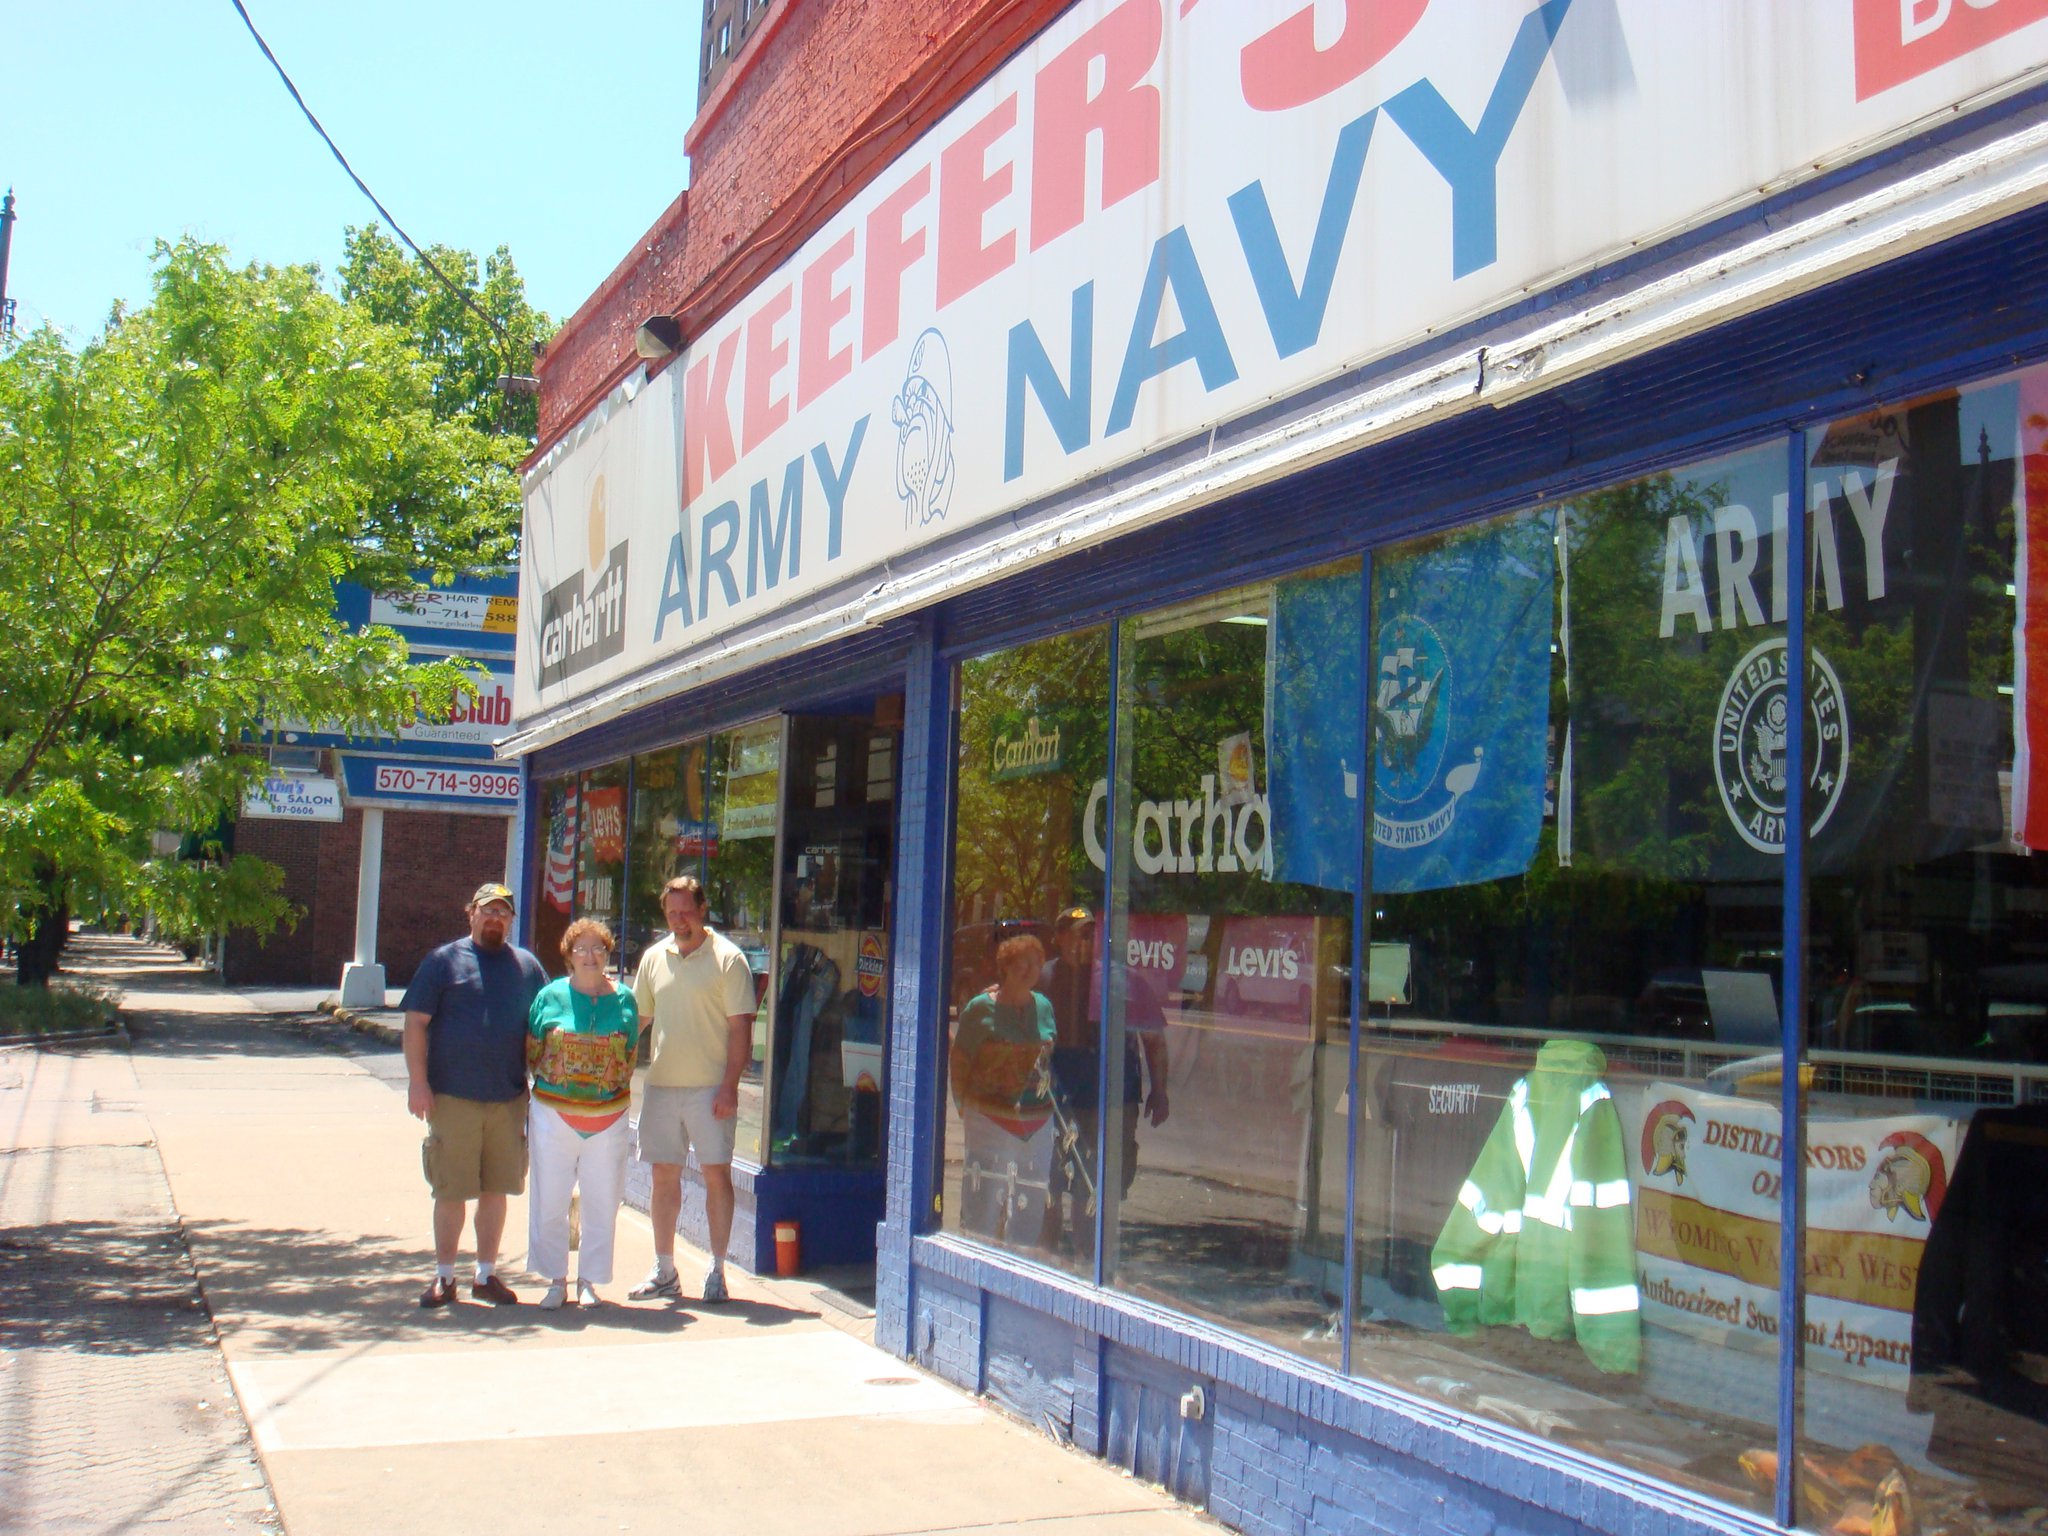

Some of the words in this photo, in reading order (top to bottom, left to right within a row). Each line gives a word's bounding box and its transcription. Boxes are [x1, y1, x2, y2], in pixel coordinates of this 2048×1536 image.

[681, 0, 1430, 513] KEEFER
[653, 413, 871, 644] ARMY
[1004, 0, 1572, 484] NAVY
[446, 593, 479, 604] HAIR
[450, 686, 512, 726] Club
[1722, 656, 1772, 752] UNITED
[1779, 651, 1839, 741] STES
[414, 726, 482, 742] Guaranteed
[287, 794, 333, 805] SALON
[379, 769, 520, 796] 570-714-9996
[1374, 818, 1393, 842] ITED
[1395, 824, 1426, 844] STATES
[1427, 804, 1454, 837] NAVY
[1749, 811, 1787, 843] AR
[1126, 938, 1176, 971] evi's
[1428, 1084, 1480, 1114] SECURITY
[1703, 1120, 1867, 1172] DISTRITORS
[1745, 1236, 1847, 1280] VALEY
[1746, 1299, 1828, 1347] Stunt
